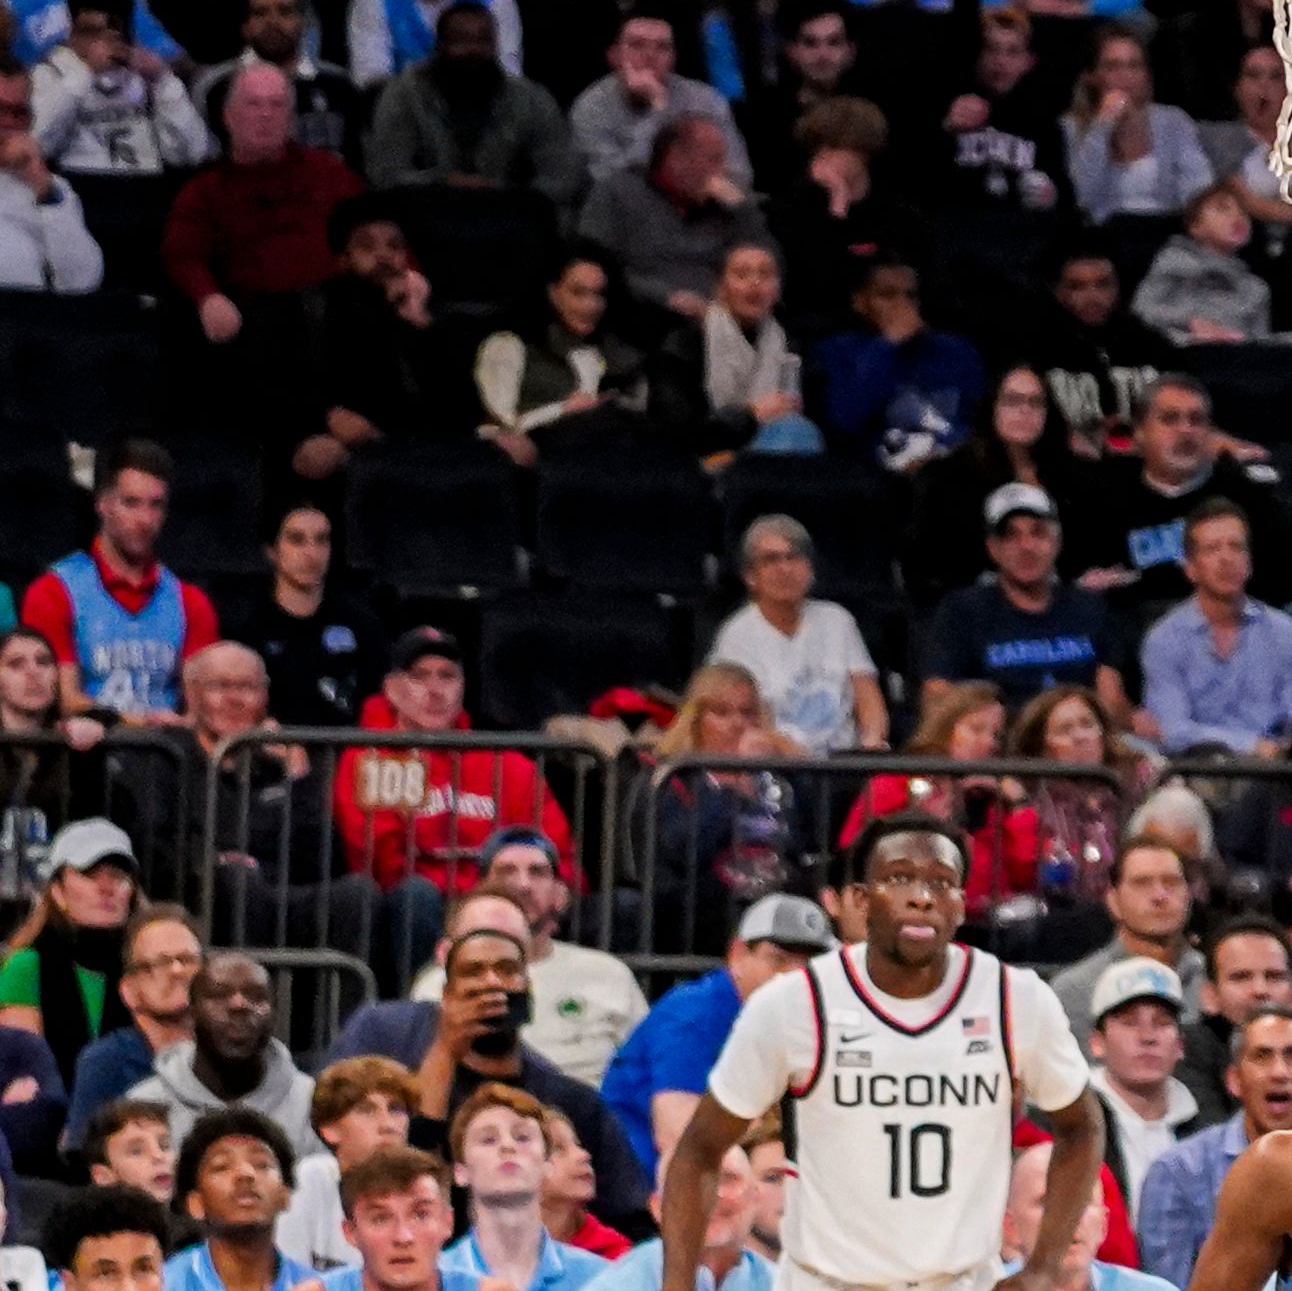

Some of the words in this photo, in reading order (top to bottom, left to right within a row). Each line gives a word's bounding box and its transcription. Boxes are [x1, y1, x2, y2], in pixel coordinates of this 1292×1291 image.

[362, 758, 425, 807] 108
[833, 1074, 1000, 1107] UCONN
[883, 1123, 951, 1199] 10
